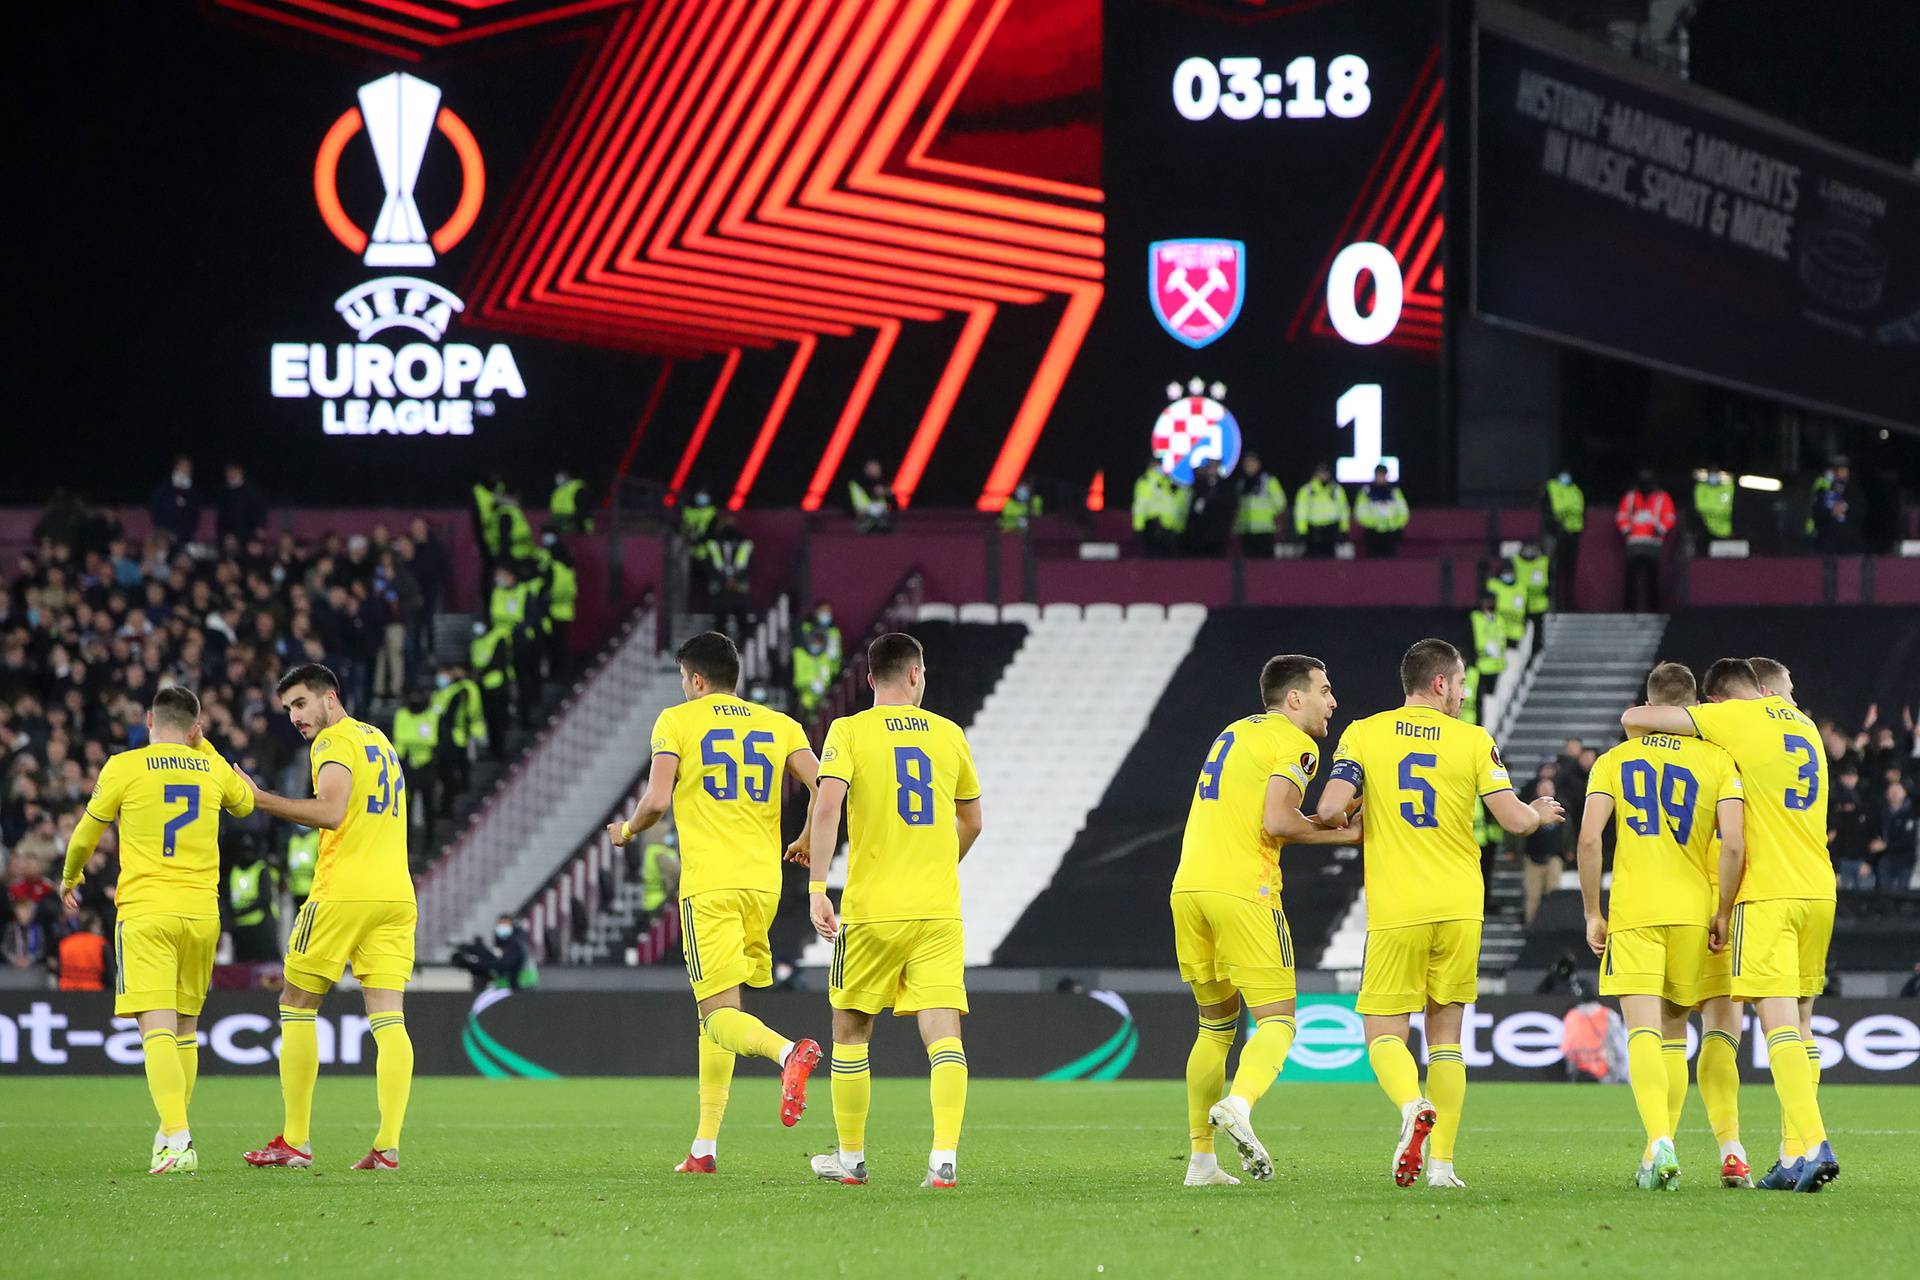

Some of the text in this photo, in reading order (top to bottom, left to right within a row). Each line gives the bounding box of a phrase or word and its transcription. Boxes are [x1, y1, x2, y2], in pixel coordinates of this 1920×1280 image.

[1172, 54, 1371, 120] 03:18
[1692, 132, 1801, 211] MOMENTS
[1638, 163, 1713, 228] SPORT
[1728, 196, 1795, 261] MORE
[342, 288, 452, 333] UEFA
[1327, 241, 1403, 345] 0
[271, 343, 526, 398] EUROPA
[322, 399, 474, 435] LEAGUE
[1336, 384, 1399, 483] 1
[700, 728, 774, 802] 55
[1198, 731, 1235, 800] 9
[1396, 720, 1440, 740] ADEMI
[366, 744, 404, 818] 37
[894, 746, 934, 826] 8
[1398, 751, 1438, 828] 5
[1621, 758, 1700, 845] 99
[1784, 733, 1819, 811] 3
[162, 784, 200, 857] 7
